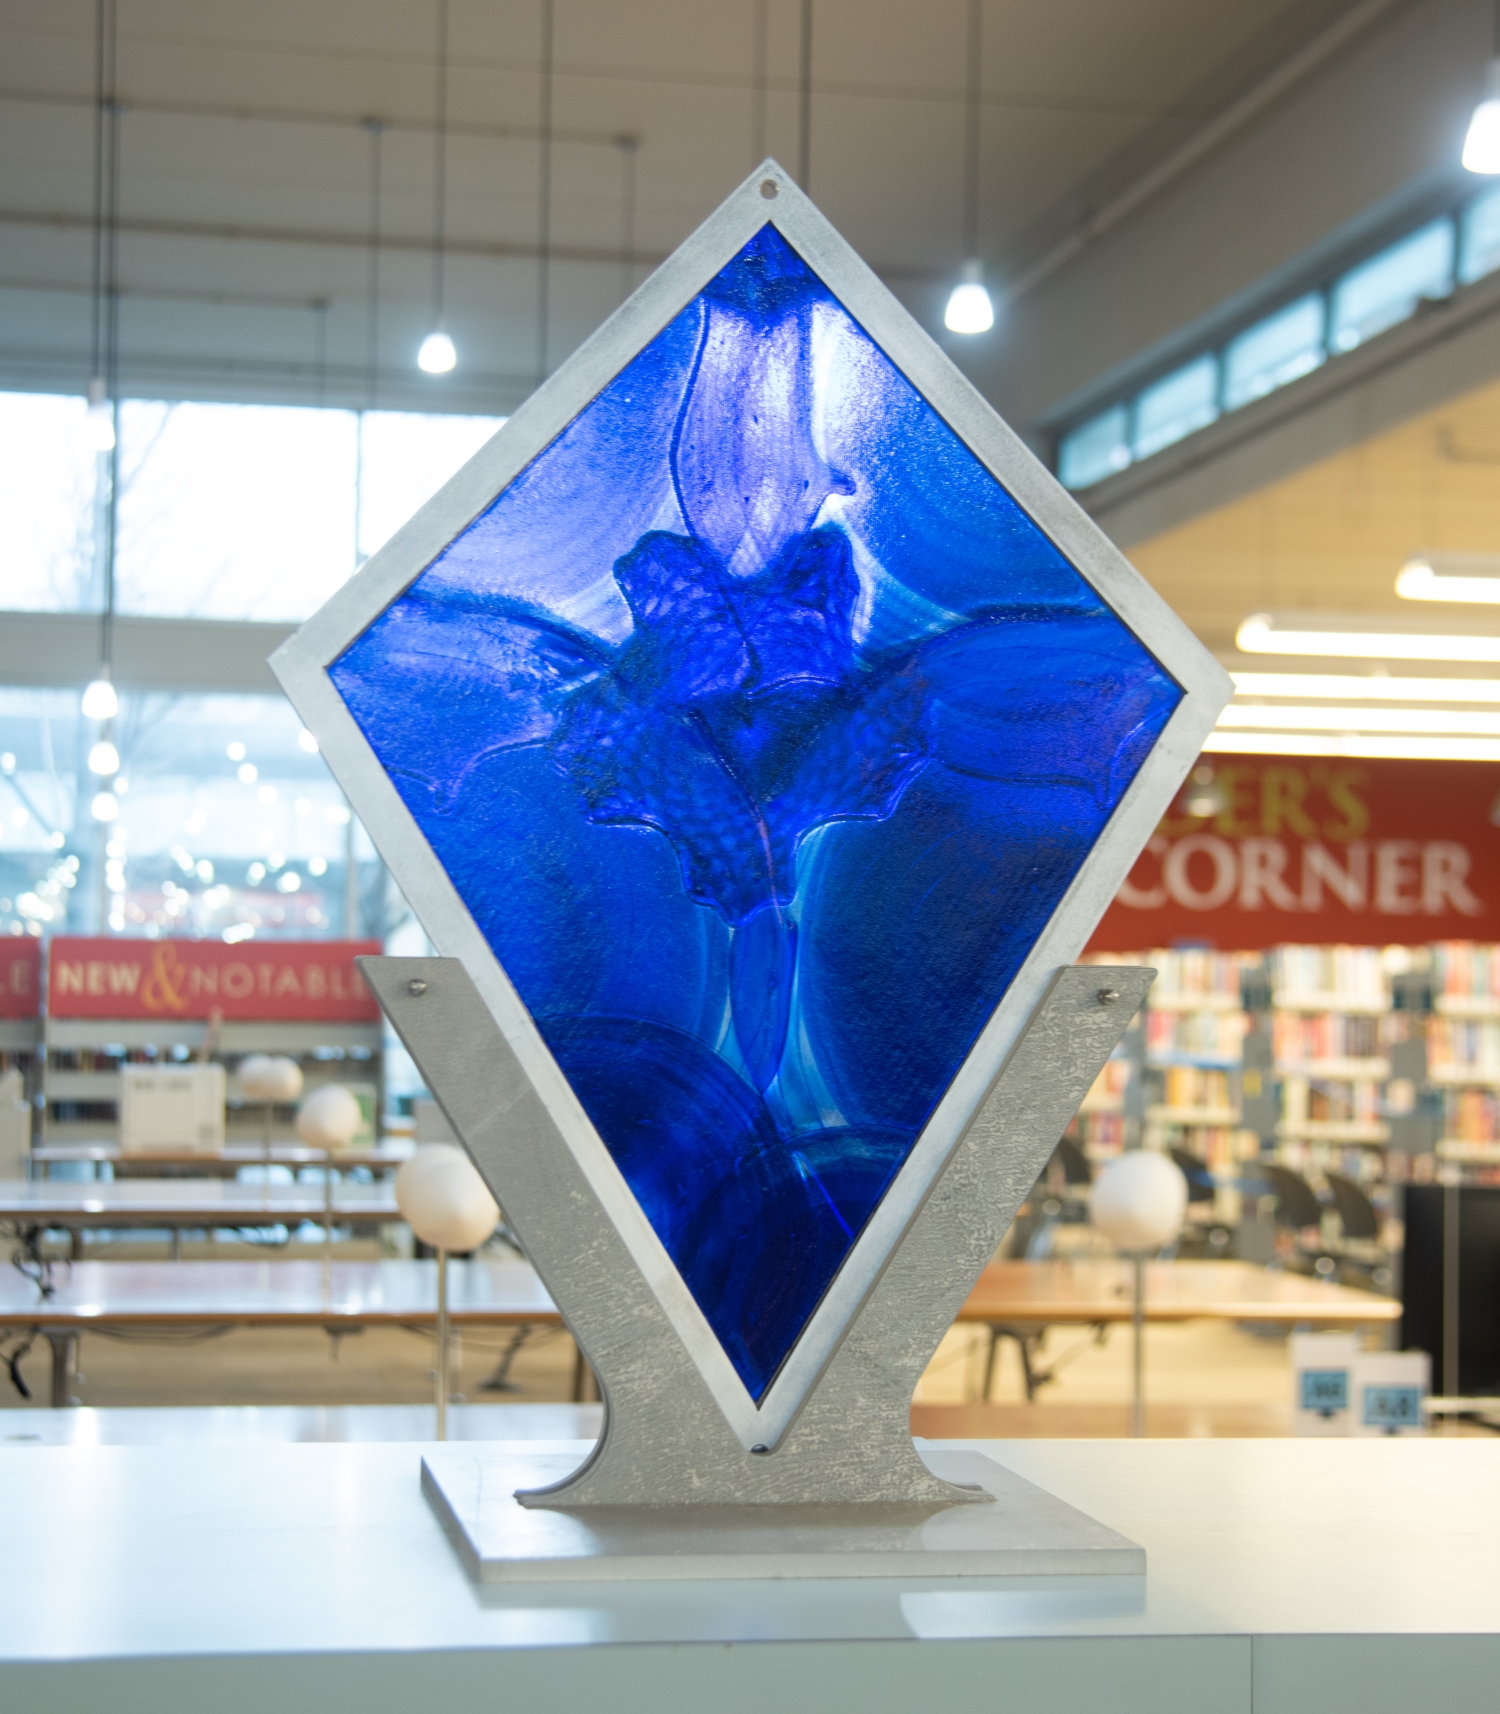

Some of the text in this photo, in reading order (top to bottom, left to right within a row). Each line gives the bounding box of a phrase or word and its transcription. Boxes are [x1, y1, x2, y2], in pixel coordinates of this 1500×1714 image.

[1112, 834, 1482, 917] CORNER
[56, 960, 141, 996] NEW
[142, 940, 190, 1012] &
